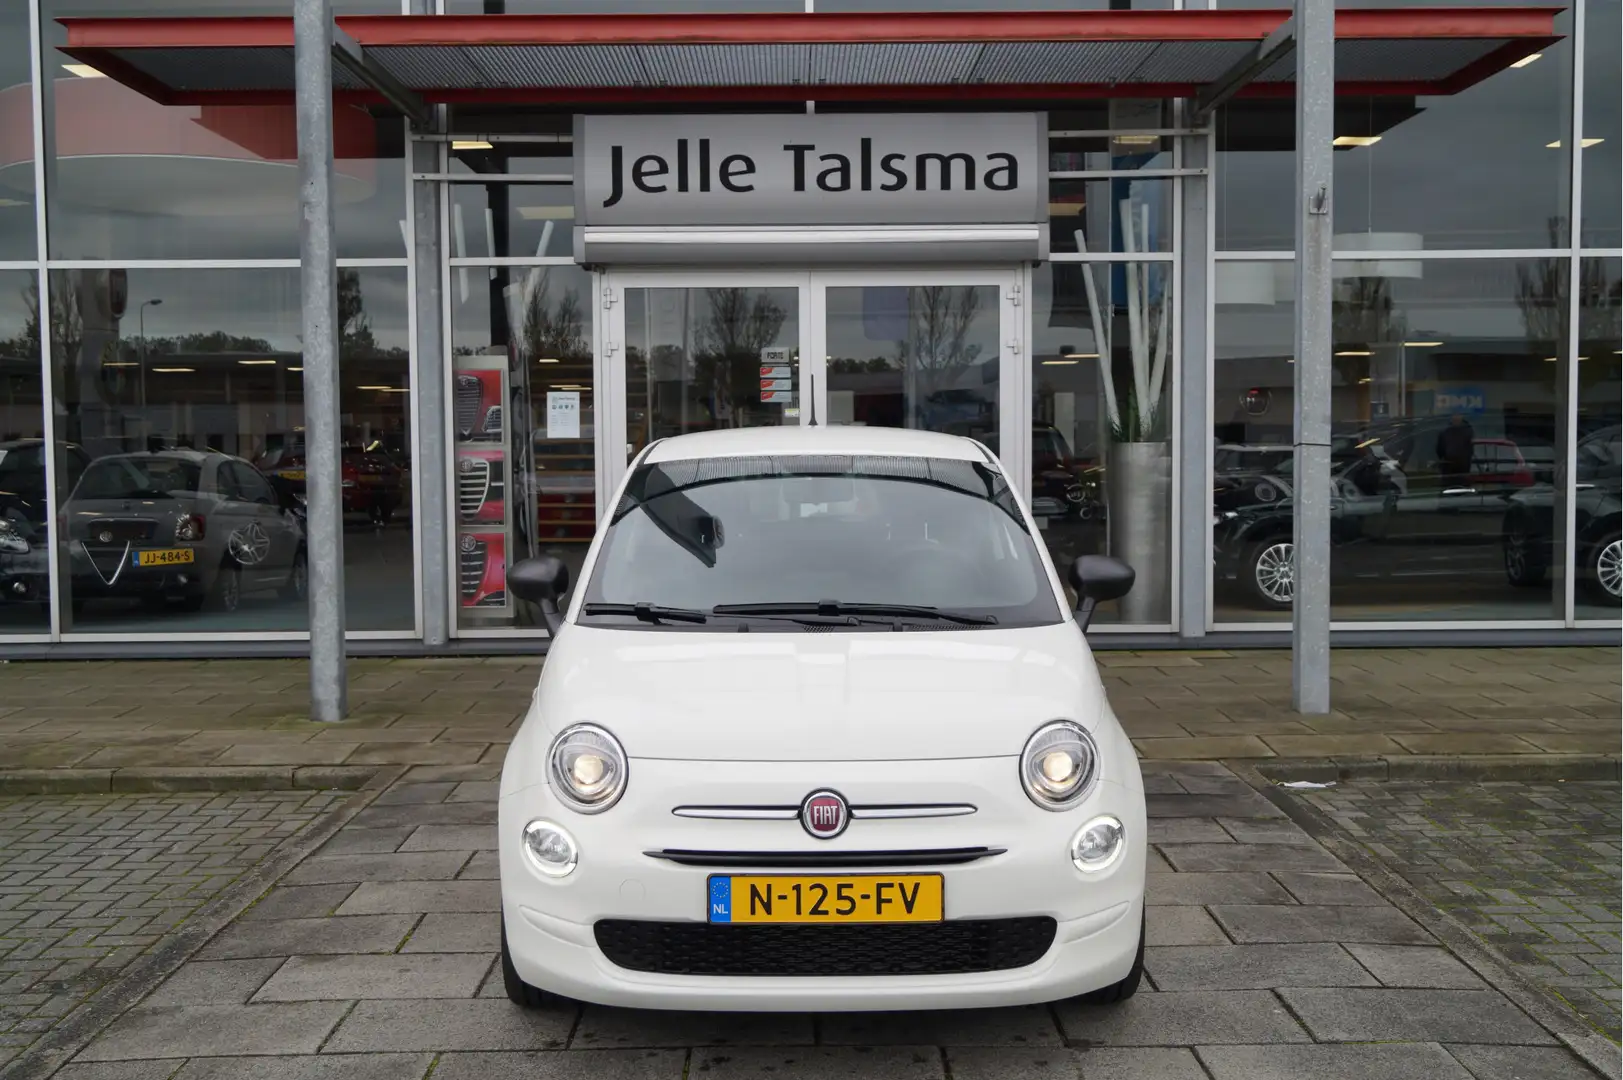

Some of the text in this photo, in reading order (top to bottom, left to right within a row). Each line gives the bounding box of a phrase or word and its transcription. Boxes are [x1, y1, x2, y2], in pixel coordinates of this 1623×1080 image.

[603, 137, 1019, 208] Jelle Talsma
[144, 550, 190, 564] JJ-484-S
[813, 805, 838, 825] FIAT
[713, 903, 729, 914] NL
[750, 882, 921, 916] N-125-FV
